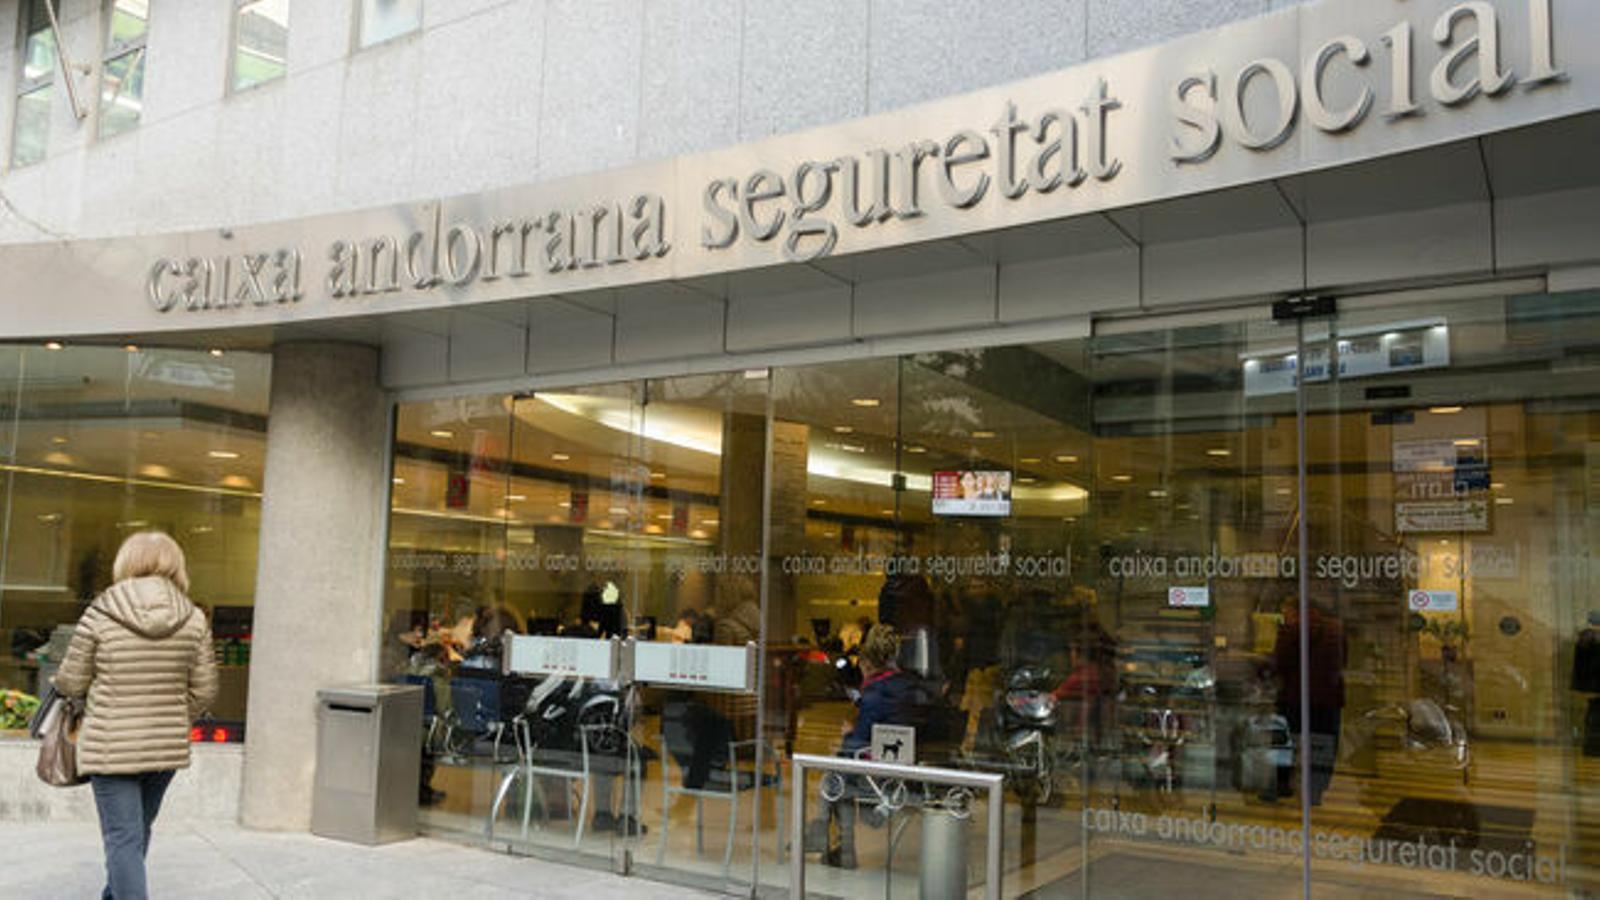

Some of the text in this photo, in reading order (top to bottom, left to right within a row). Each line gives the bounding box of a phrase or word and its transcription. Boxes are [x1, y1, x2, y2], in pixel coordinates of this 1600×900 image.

[147, 0, 1570, 314] caixa andorrana seguretat social
[782, 549, 825, 574] caixa
[926, 549, 1009, 583] seguretat
[1015, 545, 1072, 577] social
[1109, 549, 1168, 577] caixa
[1175, 543, 1297, 578] andorrana
[1082, 799, 1567, 884] caixa andorrana seguretat social
